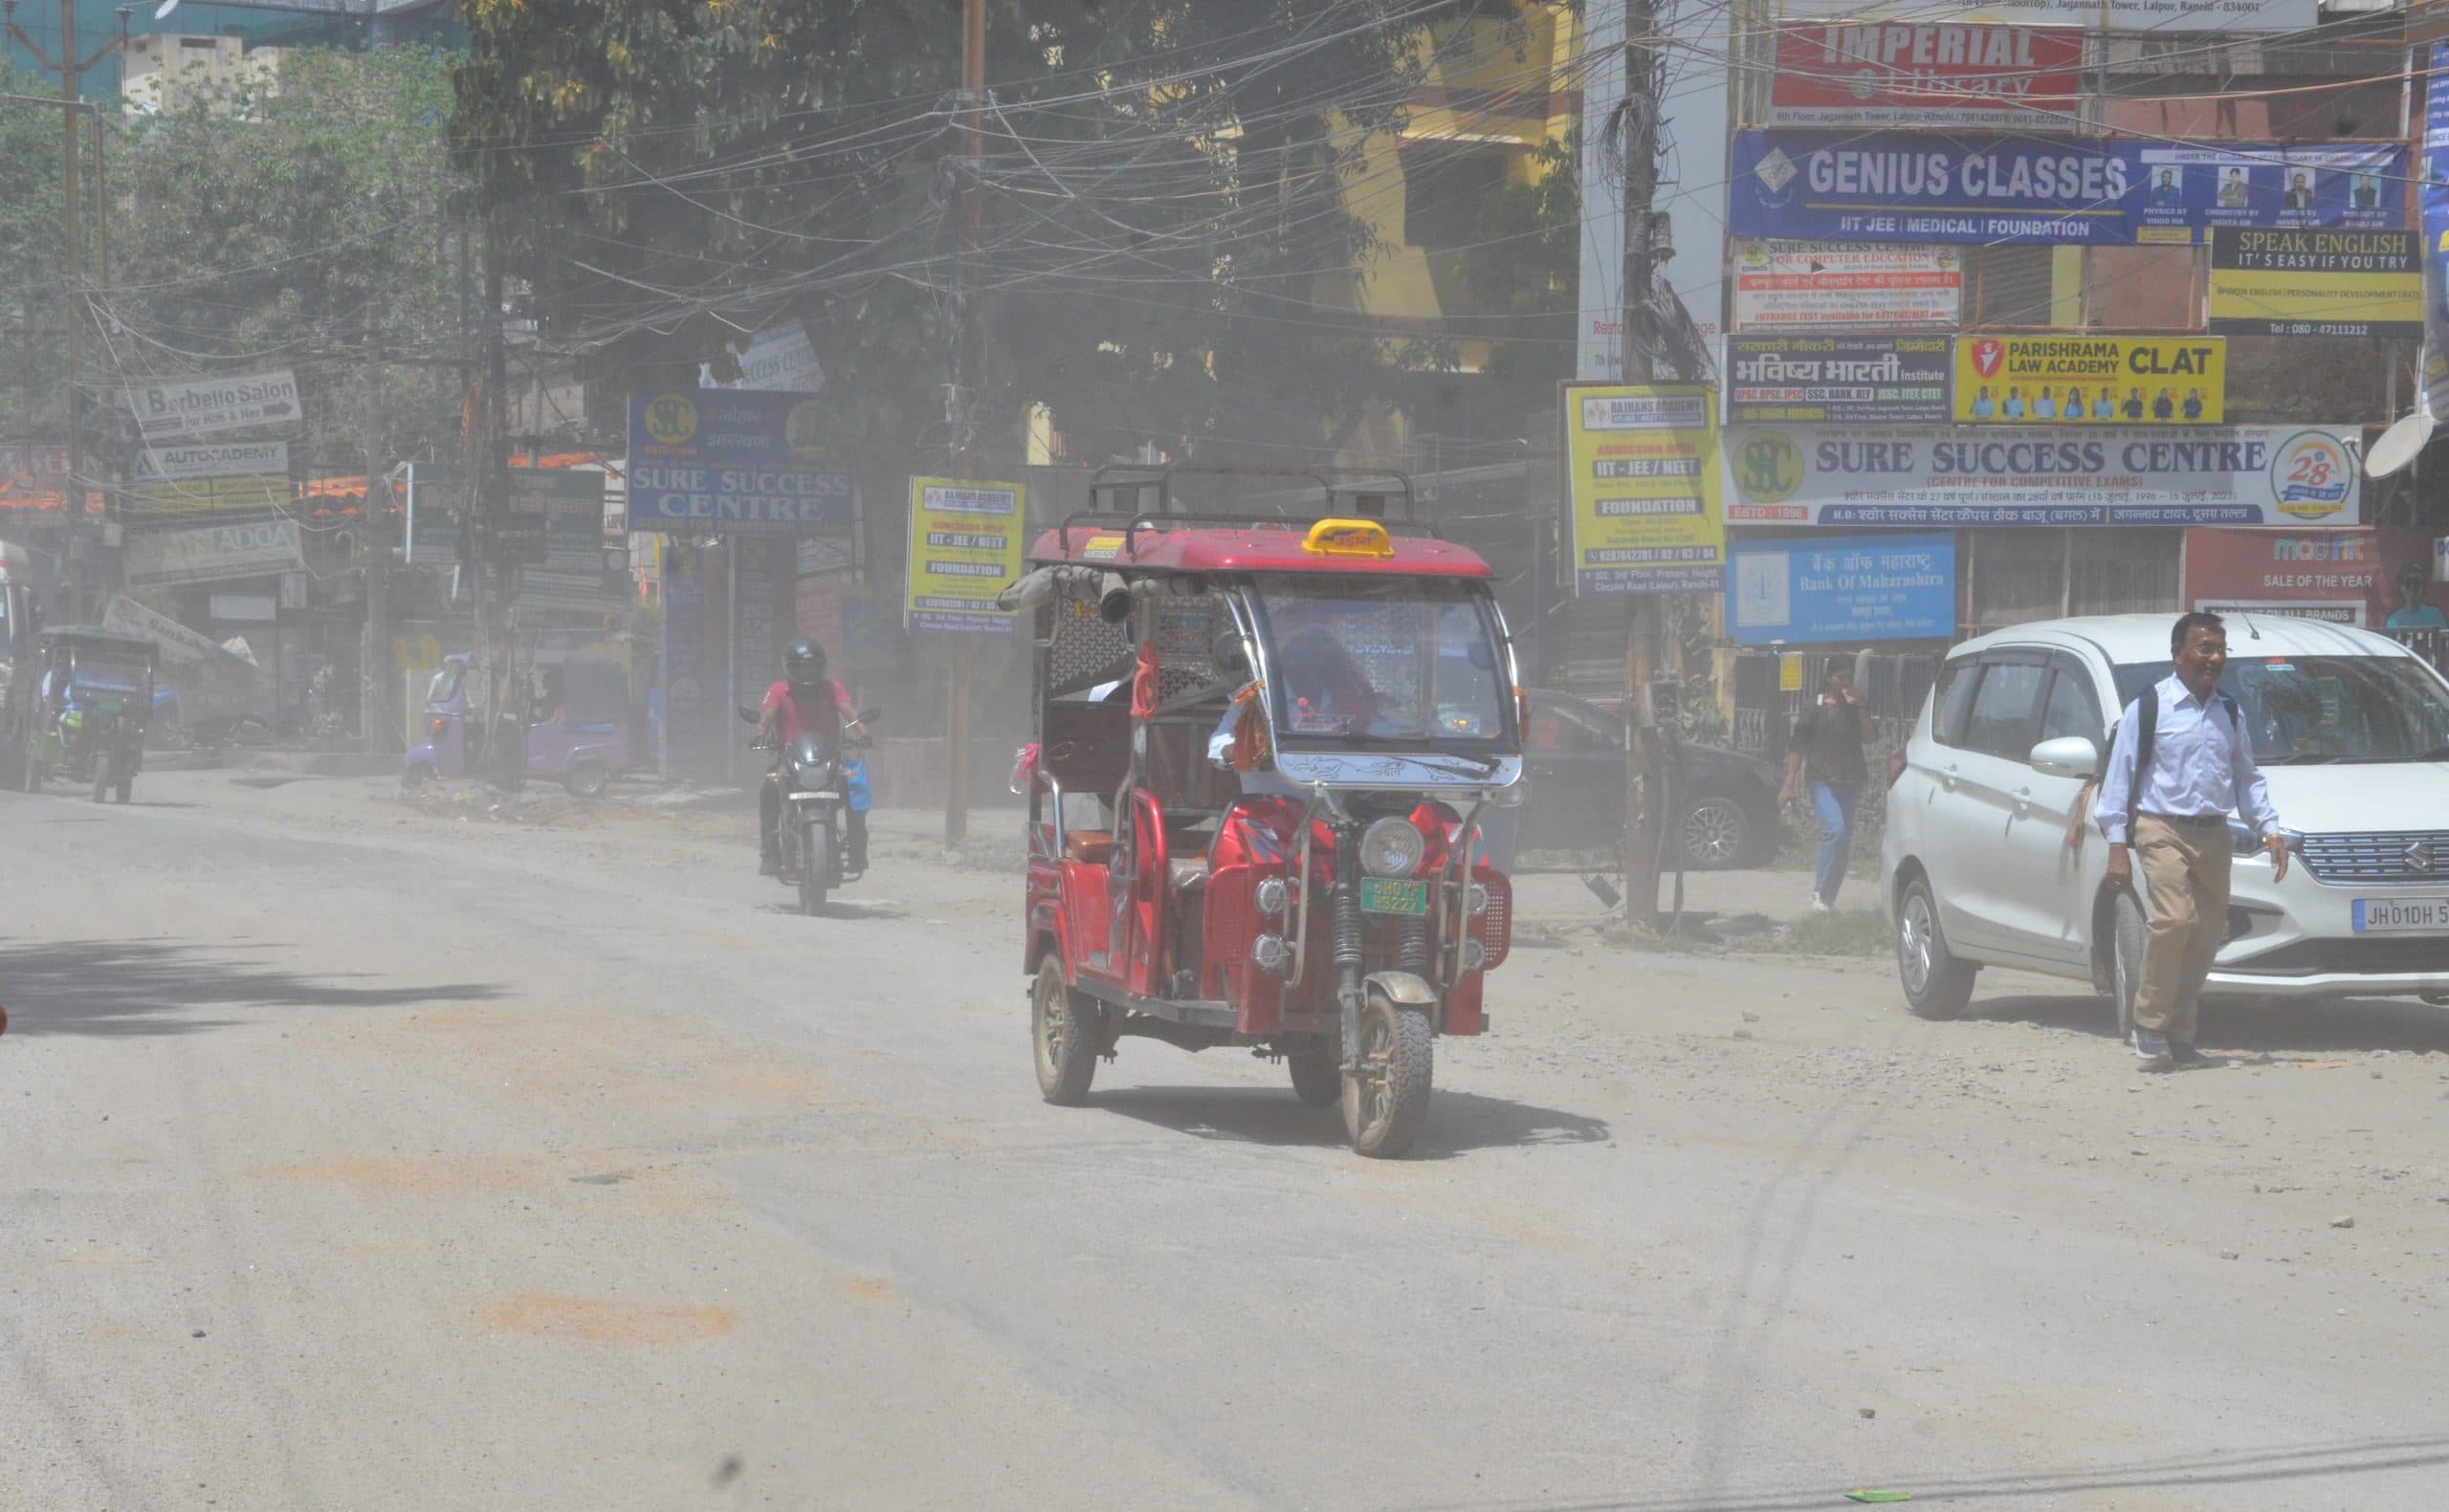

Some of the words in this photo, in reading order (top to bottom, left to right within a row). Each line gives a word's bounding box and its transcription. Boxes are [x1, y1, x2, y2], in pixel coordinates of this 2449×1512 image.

[1823, 25, 2036, 67] IMPERIAL
[1887, 67, 2034, 102] Library
[1807, 149, 1951, 197] GENIUS
[1959, 153, 2129, 203] CLASSES
[1841, 215, 1863, 232] IIT
[1865, 216, 1896, 233] JEE
[1906, 216, 1976, 234] MEDICAL
[1987, 218, 2090, 237] FOUNDATION
[1769, 242, 1806, 254] SURE
[1809, 242, 1872, 254] SUCCESS
[2239, 230, 2307, 253] SPEAK
[2314, 233, 2407, 255] ENGLISH
[1796, 252, 1862, 265] COMPUTER
[1863, 252, 1930, 264] EDUCATION
[2277, 254, 2316, 269] EASY
[2321, 255, 2335, 269] IF
[2340, 255, 2373, 270] YOU
[2378, 255, 2409, 270] TRY
[2286, 288, 2338, 298] PERSONALITY
[2340, 289, 2396, 299] DEVELOPMENT
[2270, 324, 2284, 335] Tel
[2291, 324, 2310, 335] 080
[2319, 325, 2369, 337] 47111212
[1735, 352, 1822, 383] भविष्य
[1825, 352, 1902, 383] भारती
[1900, 369, 1946, 382] Institute
[2009, 341, 2121, 362] PARISHRAMA
[2128, 346, 2213, 377] CLAT
[2009, 359, 2045, 374] LAW
[2045, 360, 2121, 375] ACADEMY
[236, 382, 295, 404] Salon
[1807, 387, 1828, 402] SSC,
[1855, 387, 1871, 401] RLY
[185, 414, 201, 427] for
[240, 407, 261, 422] Her
[164, 445, 278, 466] AUTOCADEMY
[1815, 440, 1915, 474] SURE
[1931, 440, 2107, 475] SUCCESS
[2120, 440, 2267, 473] CENTRE
[1597, 461, 1616, 476] IIT
[1627, 461, 1650, 476] JEE
[1662, 460, 1696, 475] NEET
[2287, 455, 2331, 486] 28
[632, 466, 707, 492] SURE
[719, 471, 850, 496] SUCCESS
[1928, 475, 1977, 489] (CENTRE
[1981, 475, 2007, 489] FOR
[2010, 475, 2093, 489] COMPETITIVE
[2096, 474, 2144, 489] EXAMS)
[2134, 491, 2157, 501] 1996
[2169, 492, 2180, 502] 15
[657, 493, 824, 522] CENTRE
[1600, 498, 1697, 515] FOUNDATION
[1734, 506, 1766, 519] ESTD
[1887, 508, 1928, 521] सक्सेस
[1930, 507, 1953, 521] सेंटर
[1993, 508, 2019, 521] ठीक
[2021, 509, 2050, 524] बाजू
[2050, 509, 2087, 521] (बगल)
[2090, 507, 2101, 521] में
[952, 535, 969, 547] JEE
[930, 562, 1002, 576] FOUNDATION
[1812, 553, 1836, 572] बैंक
[1842, 551, 1873, 572] ऑफ
[1880, 553, 1932, 572] महाराष्ट्र
[1625, 580, 1646, 591] Road
[1799, 575, 1834, 591] Bank
[1837, 574, 1854, 591] Of
[1858, 572, 1945, 590] Maharashtra
[2263, 574, 2293, 588] SALE
[2296, 574, 2313, 588] OF
[2316, 574, 2340, 589] THE
[2341, 574, 2372, 588] YEAR
[2305, 610, 2350, 622] BRANDS
[2367, 906, 2434, 926] JH01DH
